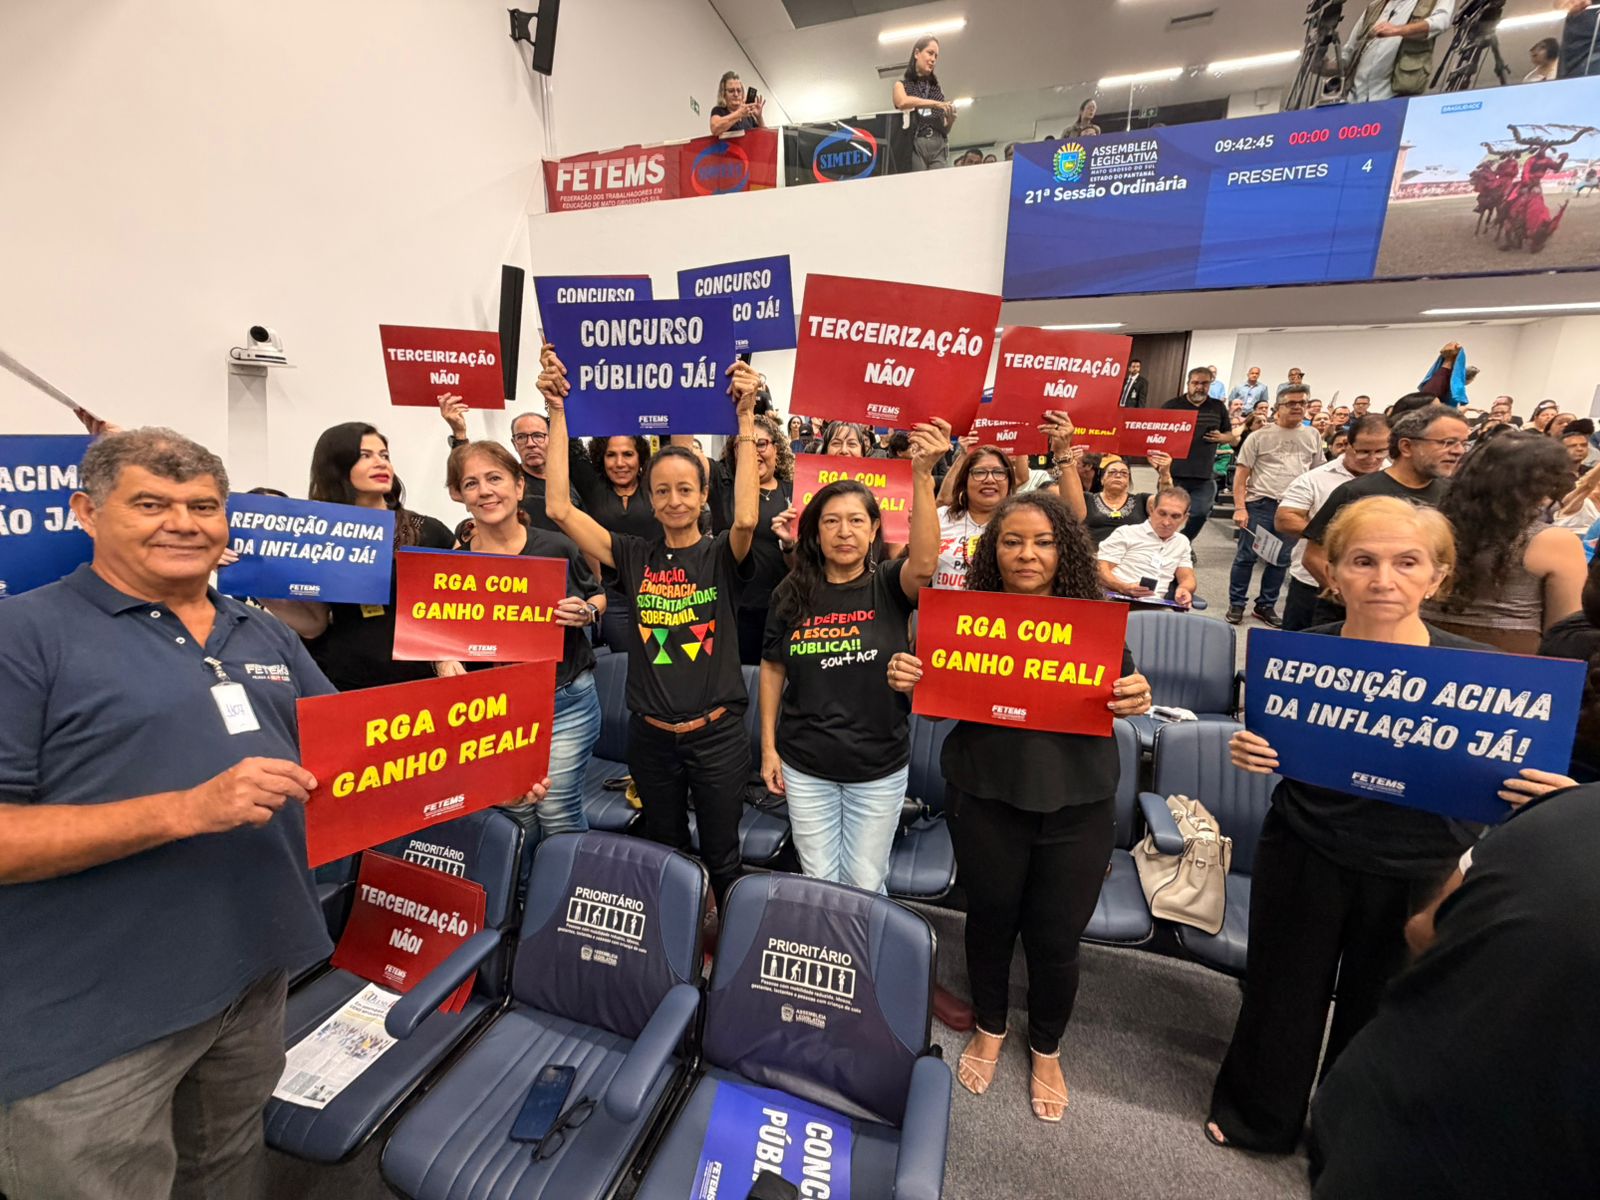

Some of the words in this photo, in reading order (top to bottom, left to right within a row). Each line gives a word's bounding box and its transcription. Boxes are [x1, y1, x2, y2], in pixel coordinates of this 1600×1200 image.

[1092, 140, 1158, 156] ASSEMBLEIA
[1215, 135, 1274, 153] 09:42:45
[1289, 128, 1330, 145] 00:00
[1338, 123, 1381, 140] 00:00
[1090, 151, 1158, 167] LEGISLATIVA
[556, 153, 665, 191] FETEMS
[1090, 174, 1113, 182] ESTADO
[1123, 170, 1155, 179] PANTANAL
[1227, 163, 1329, 186] PRESENTES
[1362, 159, 1373, 173] 4
[560, 194, 592, 202] FEDERAÇÃO
[593, 193, 604, 201] DOS
[605, 189, 652, 199] TRABALHADORES
[1025, 188, 1050, 204] 21ª
[1053, 184, 1106, 201] Sessão
[1110, 175, 1187, 196] Ordinária
[562, 201, 591, 209] EDUCAÇÃO
[694, 269, 772, 297] CONCURSO
[557, 288, 635, 303] CONCURSO
[755, 296, 780, 319] JÁ!
[580, 316, 704, 348] CONCURSO
[807, 315, 983, 358] TERCEIRIZAÇÃO
[388, 347, 496, 367] TERCEIRIZAÇÃO
[1003, 352, 1121, 378] TERCEIRIZAÇÃO
[430, 368, 460, 385] NÃO!
[579, 358, 673, 391] PÚBLICO
[680, 356, 717, 389] JÁ!
[864, 359, 915, 388] NÃO!
[1043, 379, 1078, 399] NÃO!
[638, 415, 669, 423] FETEMS
[867, 403, 900, 415] FETEMS
[996, 429, 1018, 442] NÃO!
[1125, 421, 1192, 433] TERCEIRIZAÇÃO
[1146, 433, 1167, 444] NÃO!
[0, 465, 83, 492] ACIM
[818, 470, 849, 484] RGA
[855, 473, 887, 488] COM
[230, 511, 328, 537] REPOSIÇÃO
[330, 522, 384, 541] ACIMA
[233, 538, 255, 556] DA
[260, 539, 346, 565] INFLAÇÃO
[348, 541, 376, 565] JÁ!
[289, 584, 320, 592] FETEMS
[433, 573, 477, 591] RGA
[485, 575, 529, 594] COM
[412, 601, 485, 621] GANHO
[492, 605, 554, 623] REAL!
[791, 629, 801, 641] A
[803, 625, 860, 639] ESCOLA
[956, 615, 1007, 640] RGA
[1017, 619, 1073, 646] COM
[468, 644, 497, 652] FETEMS
[790, 638, 862, 657] PÚBLICA!!
[244, 664, 289, 676] FETEMS
[931, 648, 1015, 677] GANHO
[1023, 657, 1106, 687] REAL!
[1264, 657, 1427, 703] REPOSIÇÃO
[1432, 680, 1553, 722] ACIMA
[365, 712, 436, 747] RGA
[447, 693, 508, 728] COM
[991, 704, 1027, 717] FETEMS
[1264, 694, 1299, 721] DA
[1307, 702, 1460, 750] INFLAÇÃO
[1467, 729, 1532, 764] JÁ!
[332, 750, 447, 799] GANHO
[458, 723, 539, 766] REAL!
[1352, 771, 1406, 790] FETEMS
[423, 794, 465, 814] FETEMS
[409, 839, 465, 862] PRIORITÁRIO
[575, 886, 644, 912] PRIORITÁRIO
[361, 884, 469, 937] TERCEIRIZAÇÃO
[389, 927, 424, 955] NÃO!
[768, 937, 852, 966] PRIORITÁRIO
[384, 964, 407, 979] FETEMS
